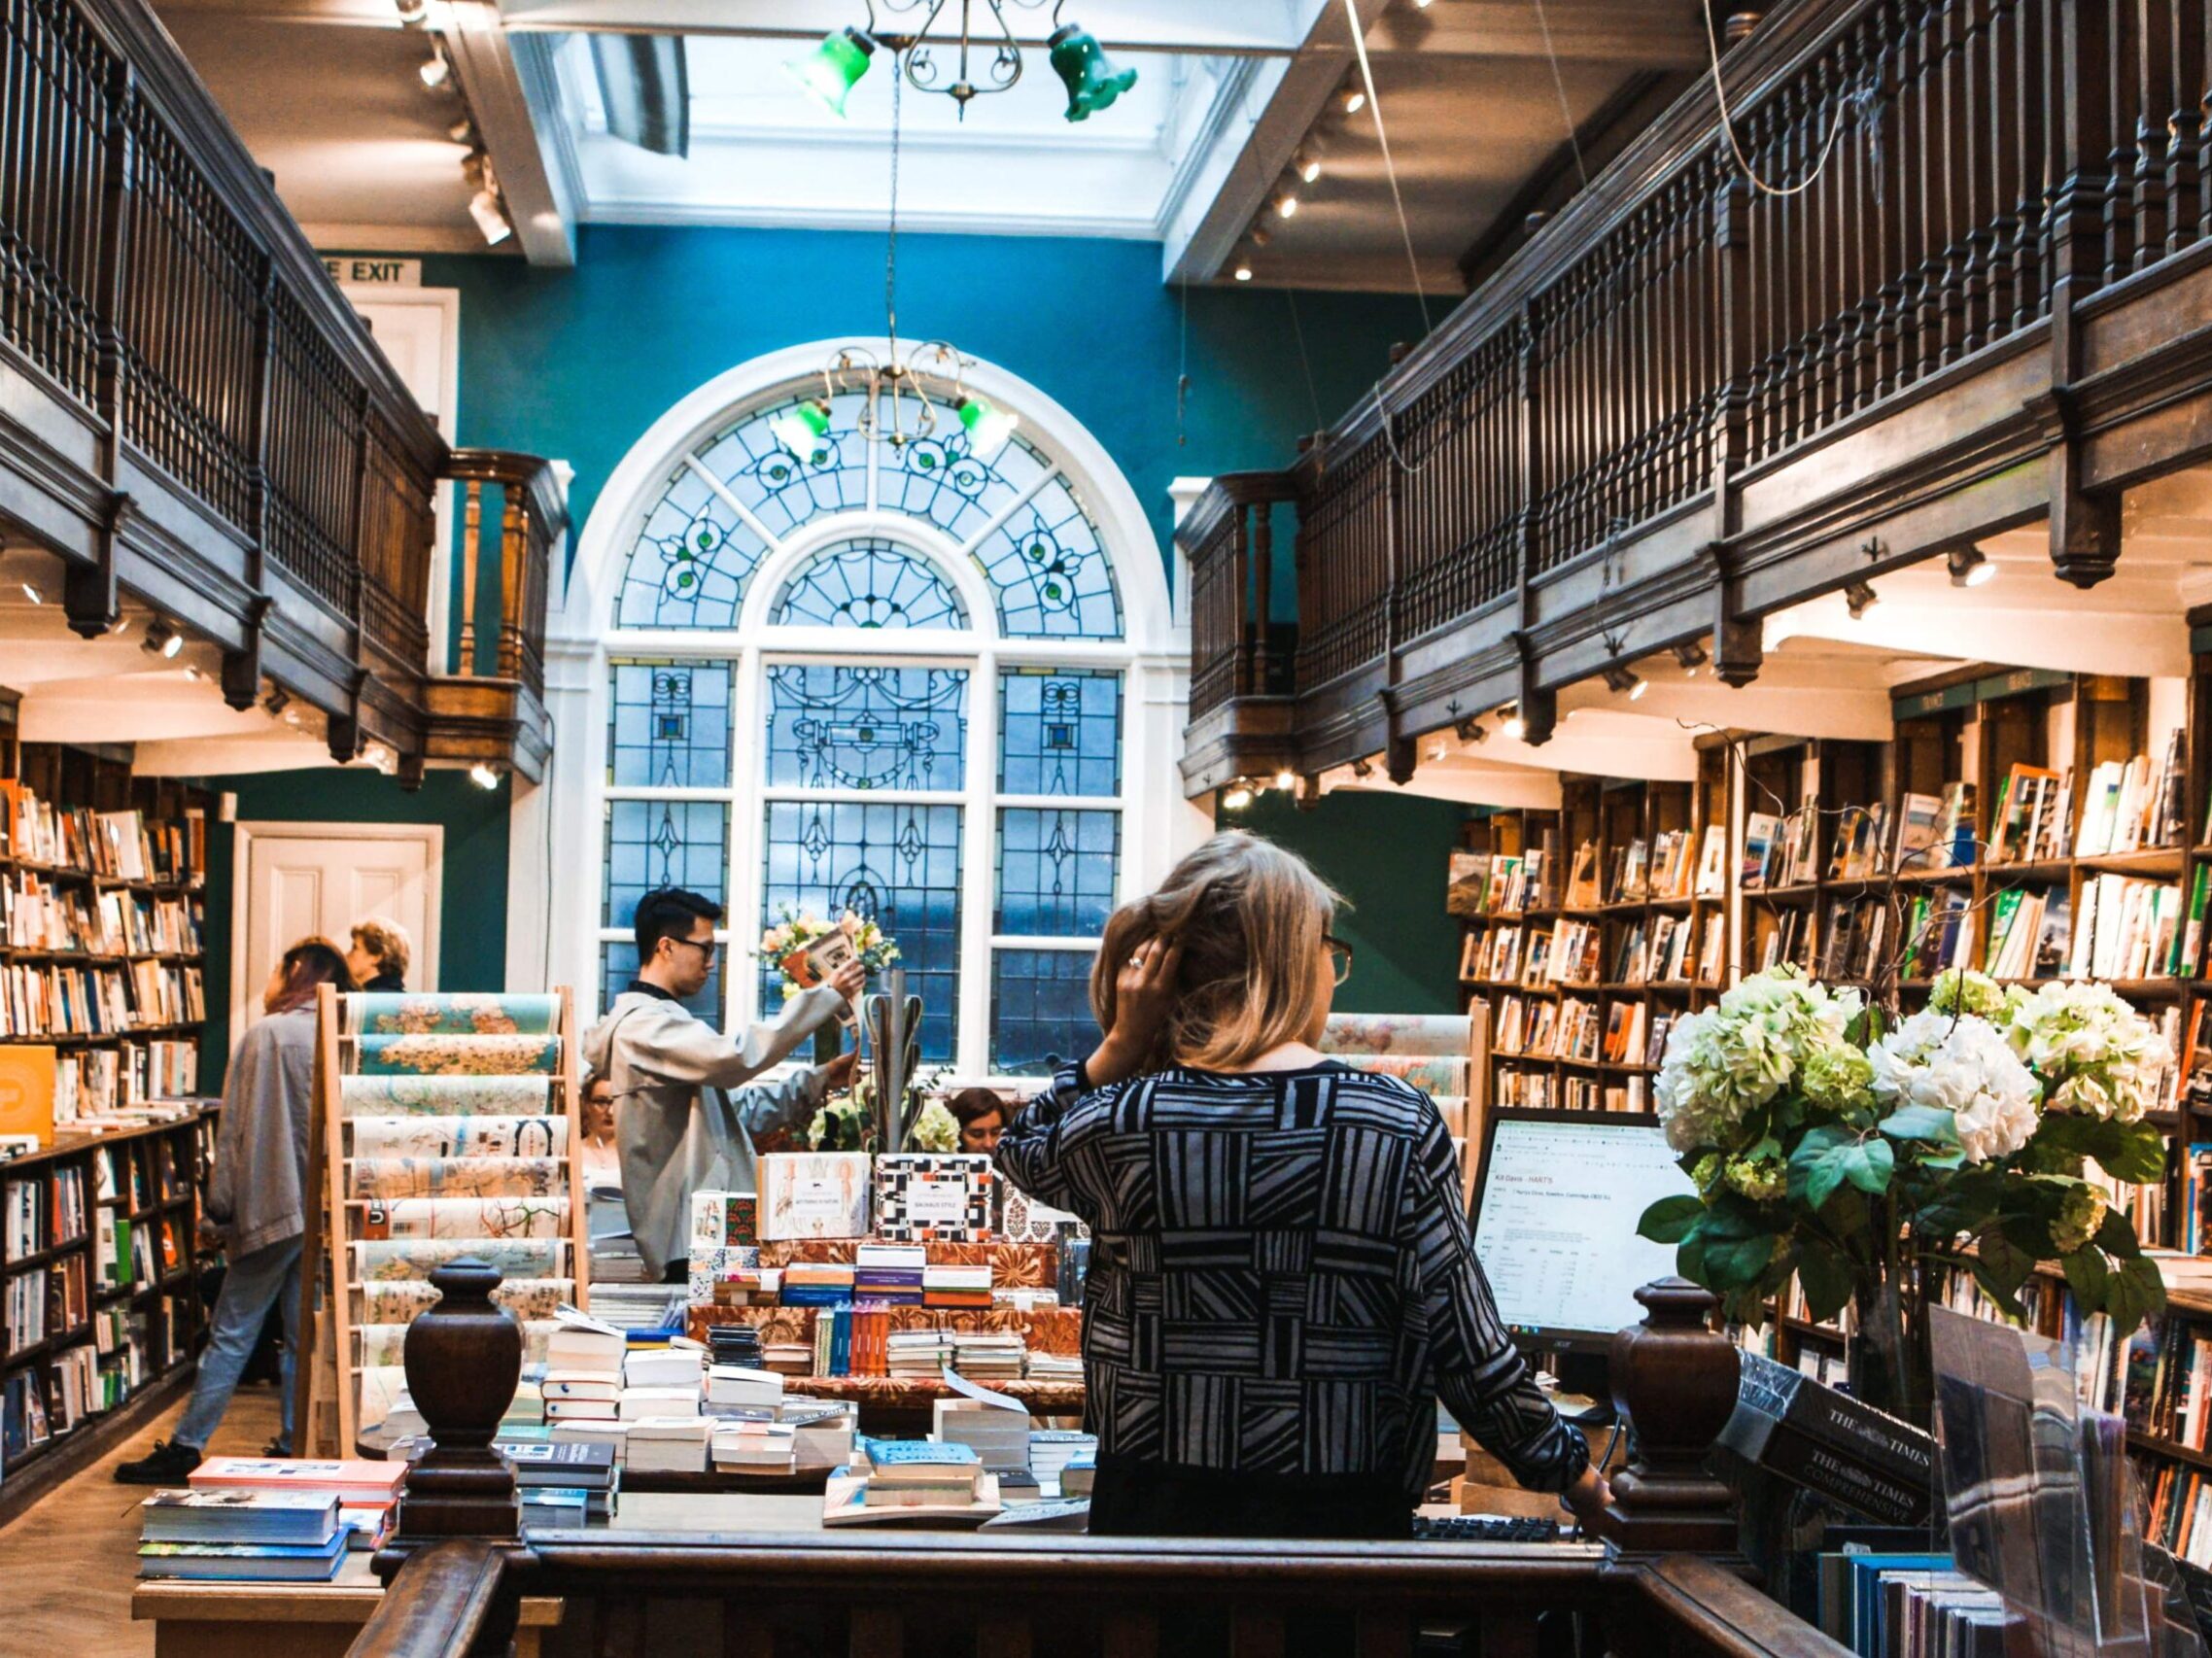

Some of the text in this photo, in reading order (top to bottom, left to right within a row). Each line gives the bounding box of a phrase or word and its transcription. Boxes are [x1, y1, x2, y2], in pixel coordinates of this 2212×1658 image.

[352, 261, 404, 282] EXIT
[1828, 1409, 1930, 1468] THE TIMES
[1804, 1464, 1911, 1524] COMPREHENSIVE
[1812, 1448, 1917, 1509] THE TIMES
